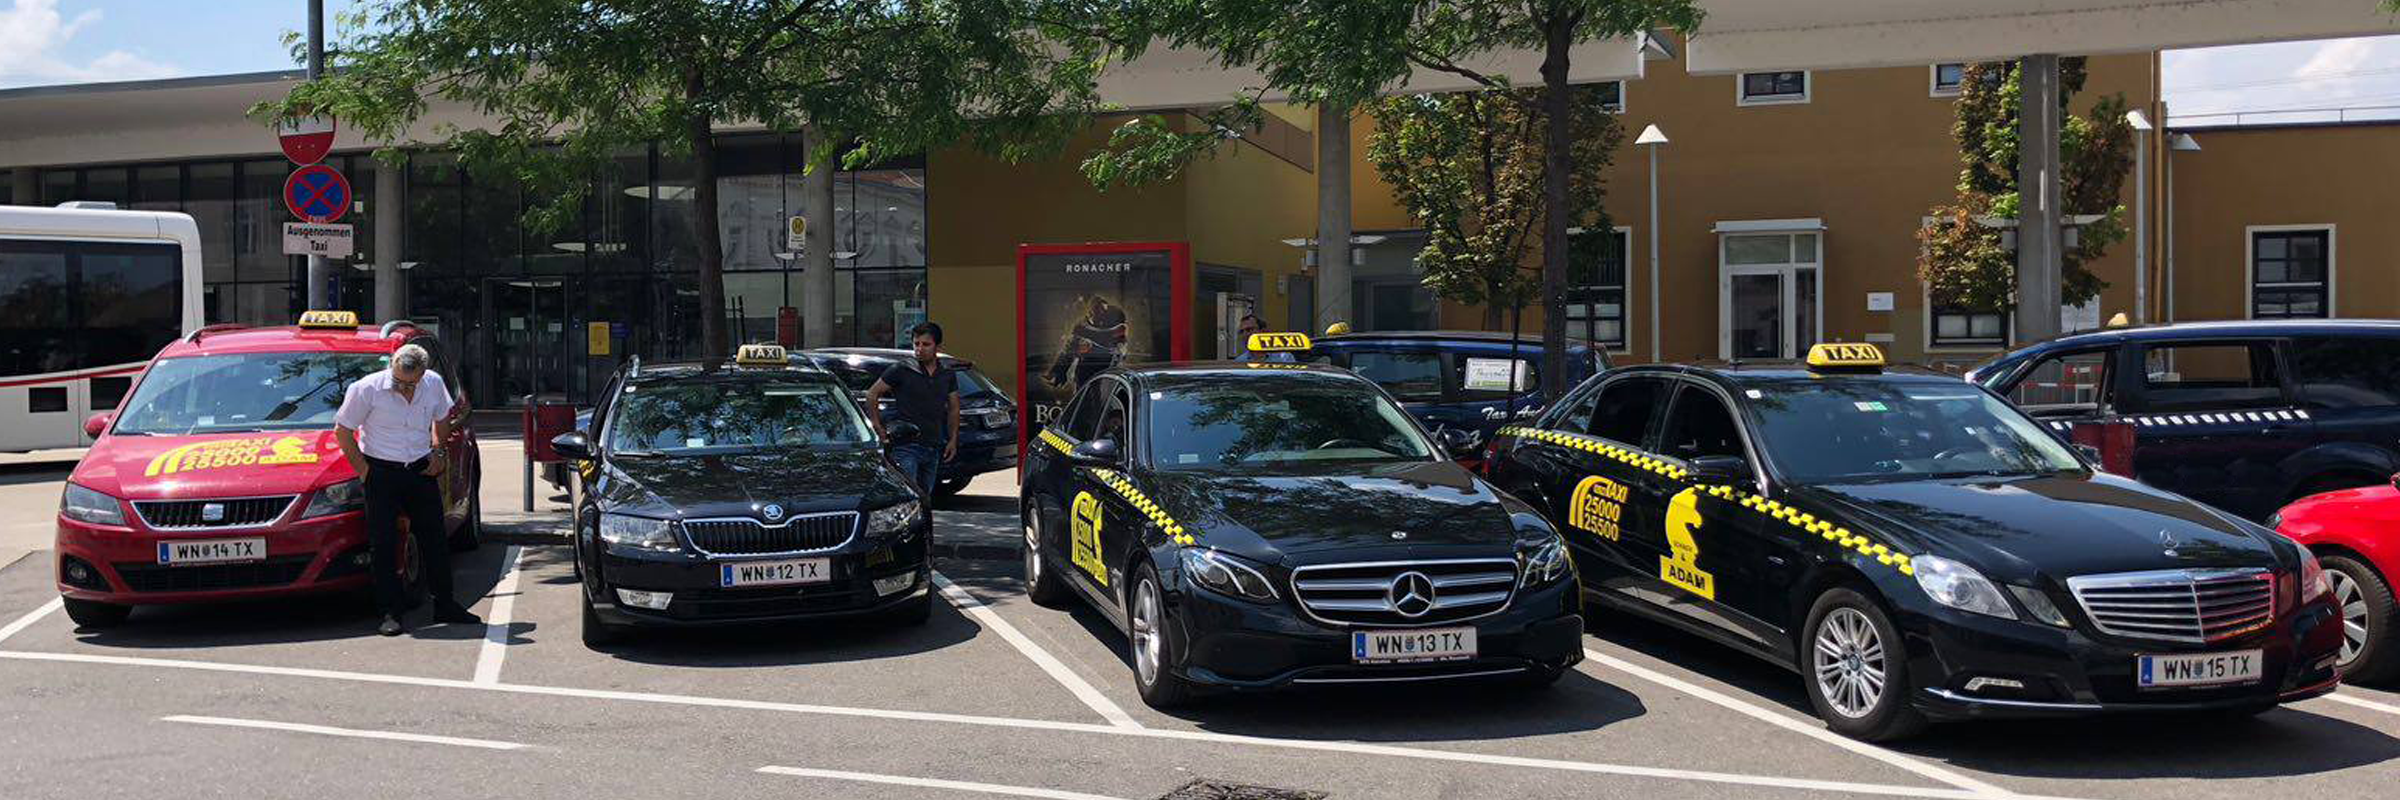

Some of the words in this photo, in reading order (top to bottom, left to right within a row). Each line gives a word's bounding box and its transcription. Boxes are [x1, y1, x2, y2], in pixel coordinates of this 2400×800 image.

[287, 225, 351, 238] Ausgenommen
[310, 241, 328, 251] Taxi
[1065, 263, 1131, 273] RONACHER
[1260, 335, 1304, 348] TAXI
[749, 347, 779, 359] TAXI
[1824, 346, 1876, 360] TAXI
[1481, 406, 1508, 420] Tax
[1585, 494, 1620, 522] 25000
[1584, 513, 1619, 541] 25500
[177, 544, 200, 558] WN
[213, 544, 229, 557] 14
[234, 542, 253, 556] TX
[741, 566, 764, 581] WN
[777, 564, 793, 579] 12
[799, 562, 817, 578] TX
[1669, 564, 1705, 590] ADAM
[1376, 635, 1402, 653] WN
[1417, 634, 1436, 652] 13
[1441, 633, 1462, 651] TX
[2164, 660, 2191, 679] WN
[2207, 658, 2224, 677] 15
[2231, 656, 2250, 675] TX
